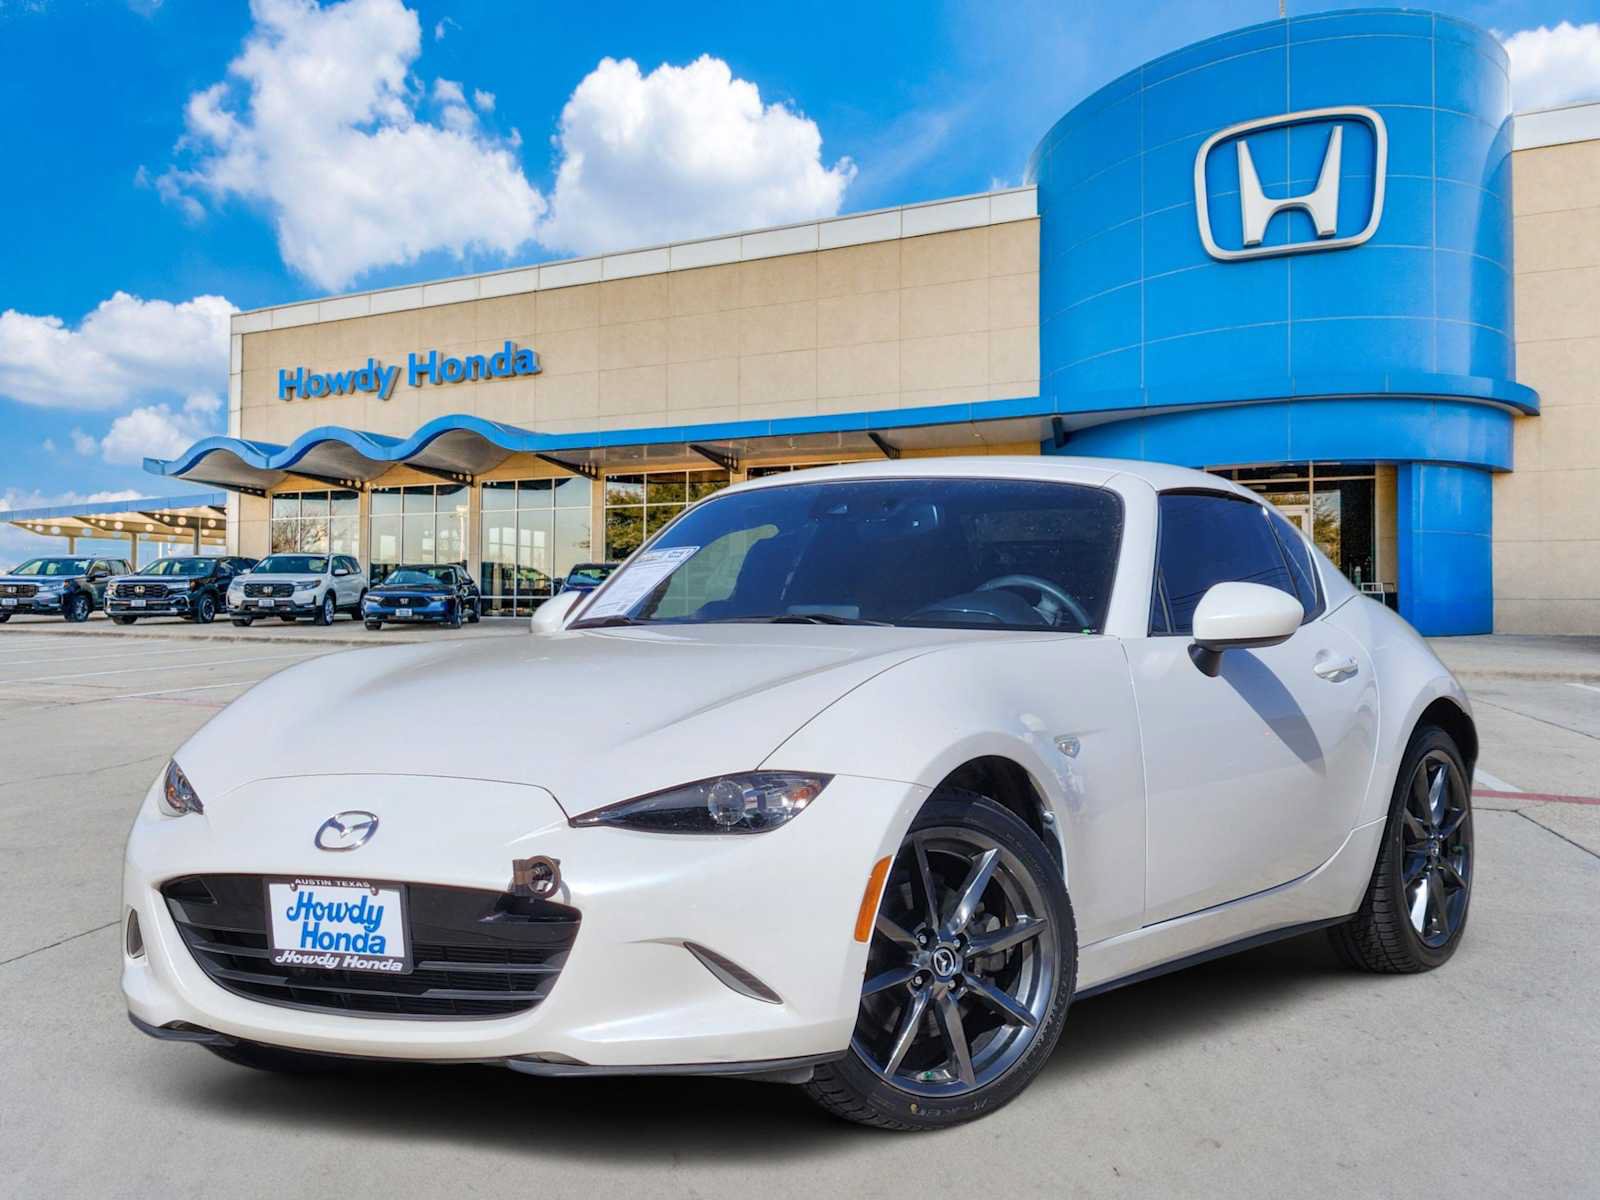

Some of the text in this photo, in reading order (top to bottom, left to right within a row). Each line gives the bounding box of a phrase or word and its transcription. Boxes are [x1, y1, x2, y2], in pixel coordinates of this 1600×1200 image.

[278, 340, 542, 400] Howdy Honda
[295, 878, 370, 888] AUSTIN TEXAS
[286, 891, 384, 933] Howdy
[300, 921, 386, 954] Honda
[275, 950, 403, 971] Howdy Honda
